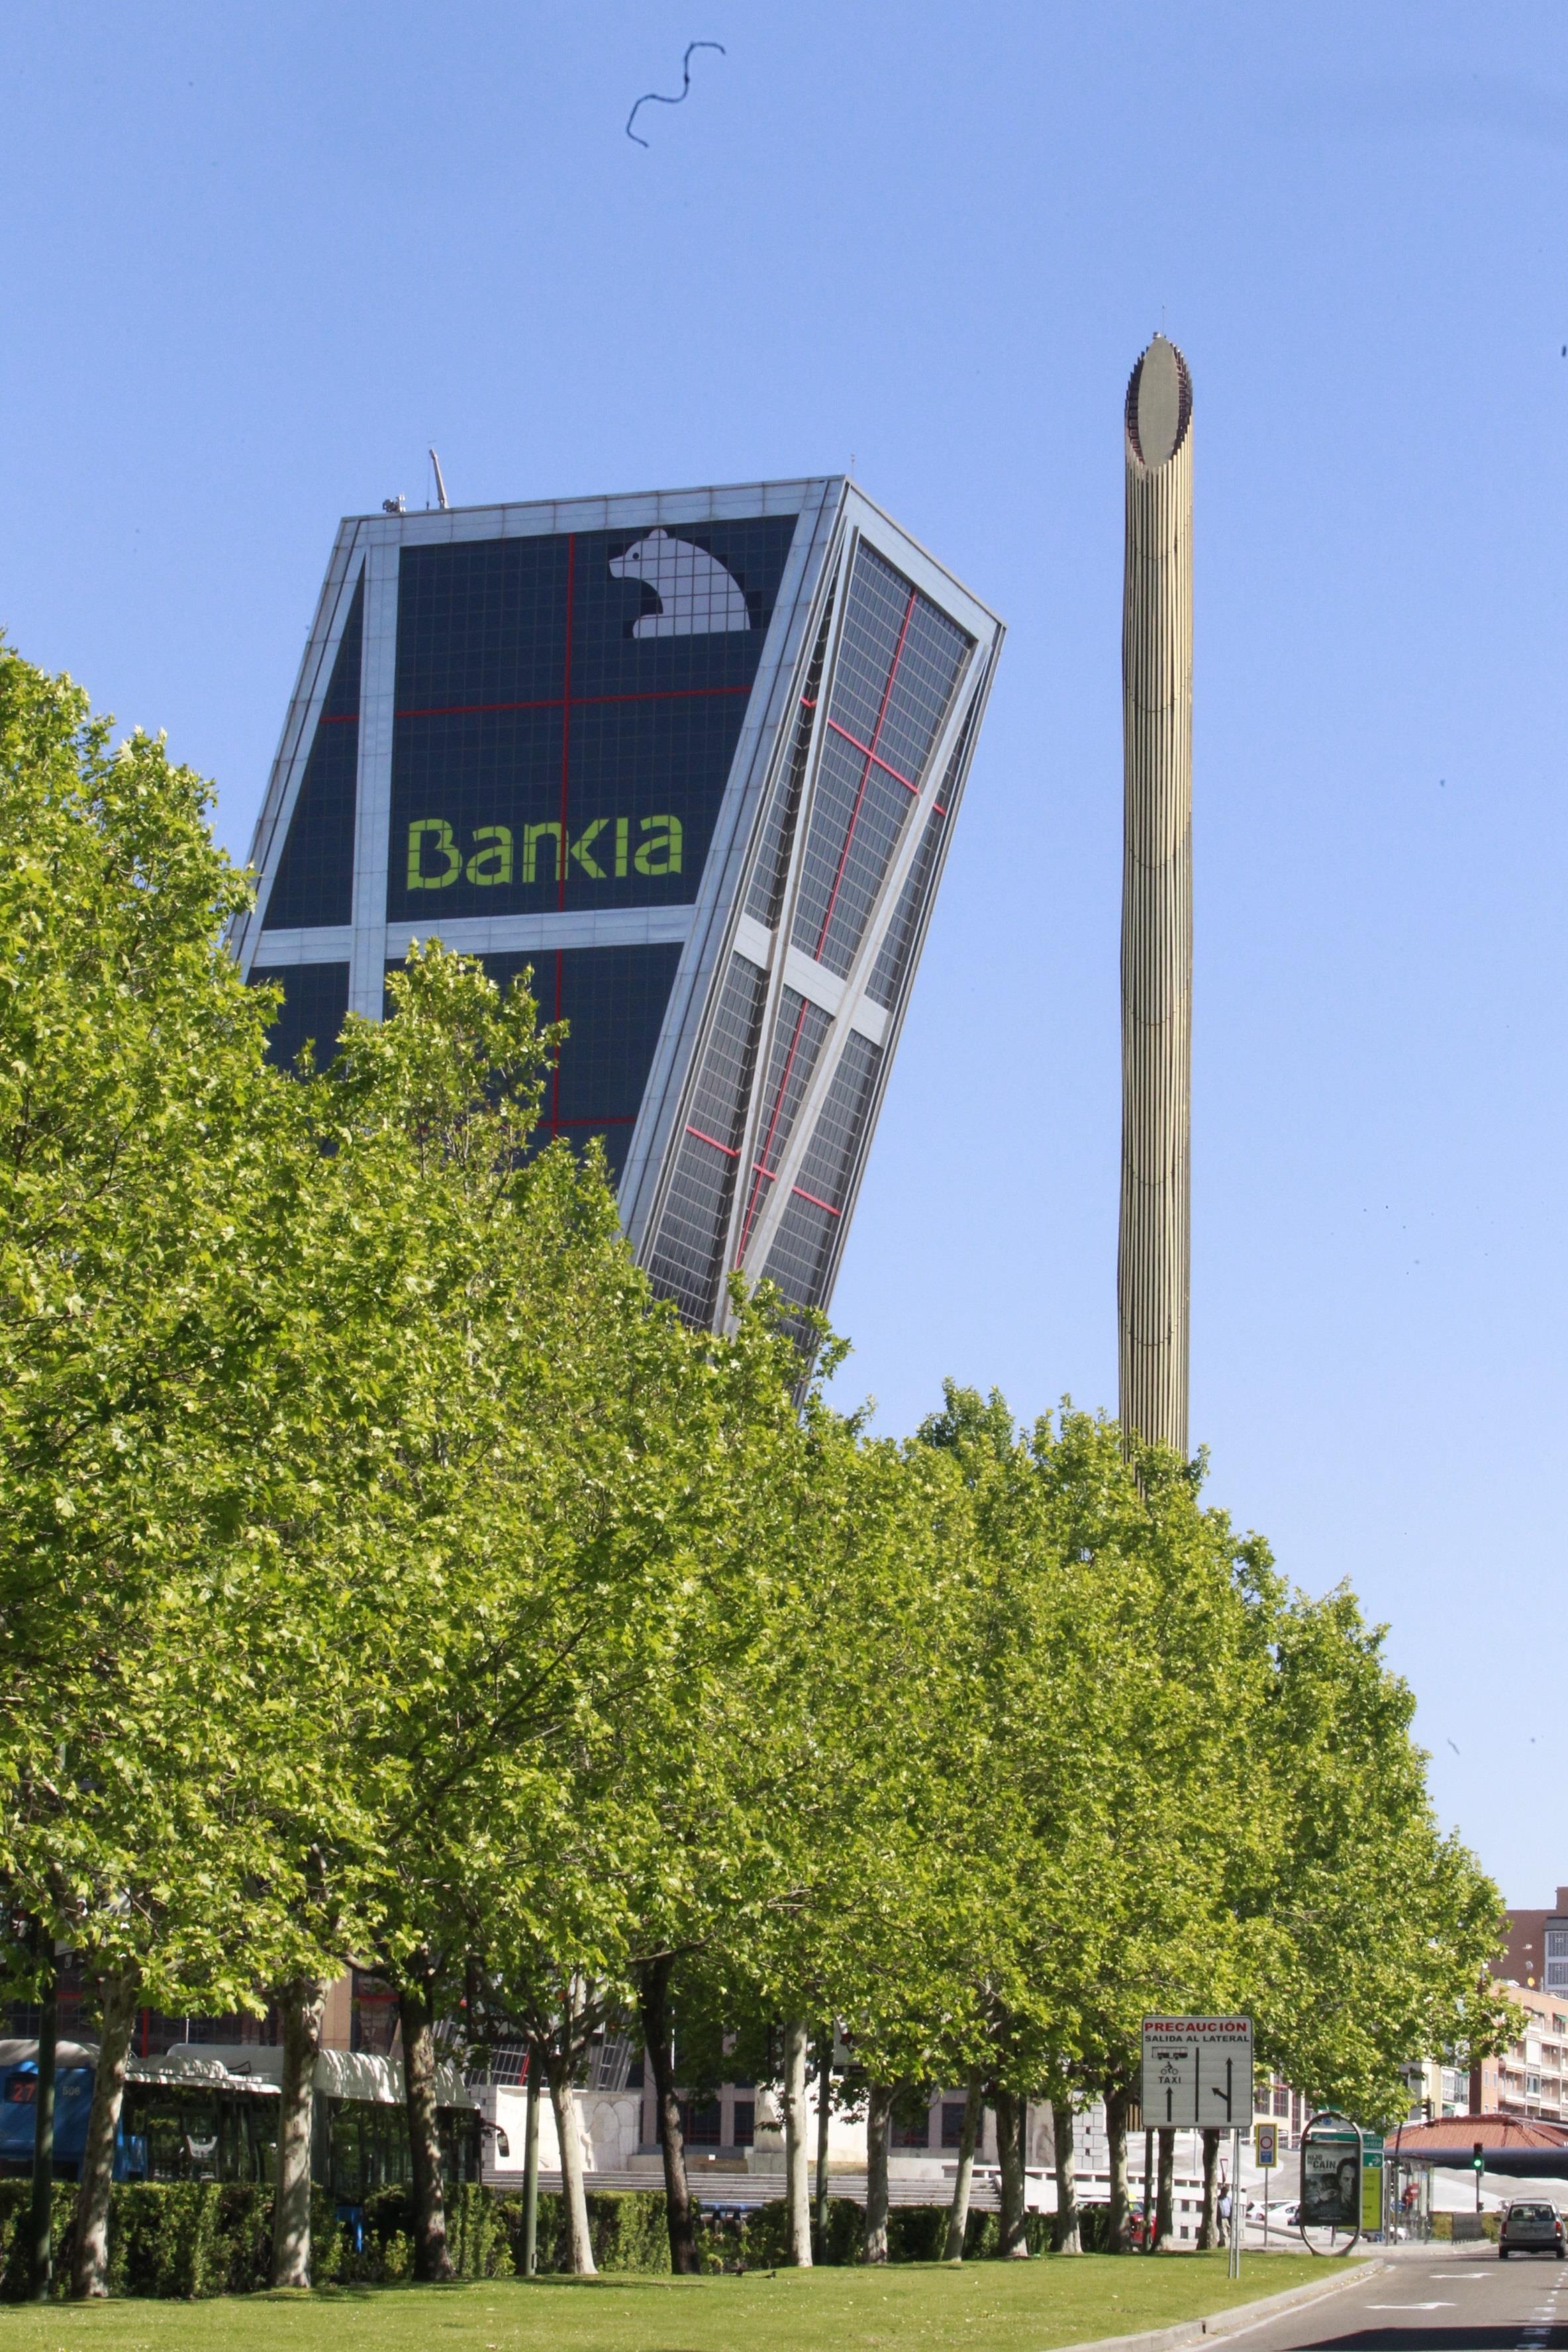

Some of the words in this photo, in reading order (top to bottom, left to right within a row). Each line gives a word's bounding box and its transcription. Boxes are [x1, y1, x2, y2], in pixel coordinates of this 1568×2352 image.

[407, 814, 683, 891] Bankia
[1144, 2020, 1247, 2032] PRECAUCIÓN
[13, 2082, 36, 2102] 27
